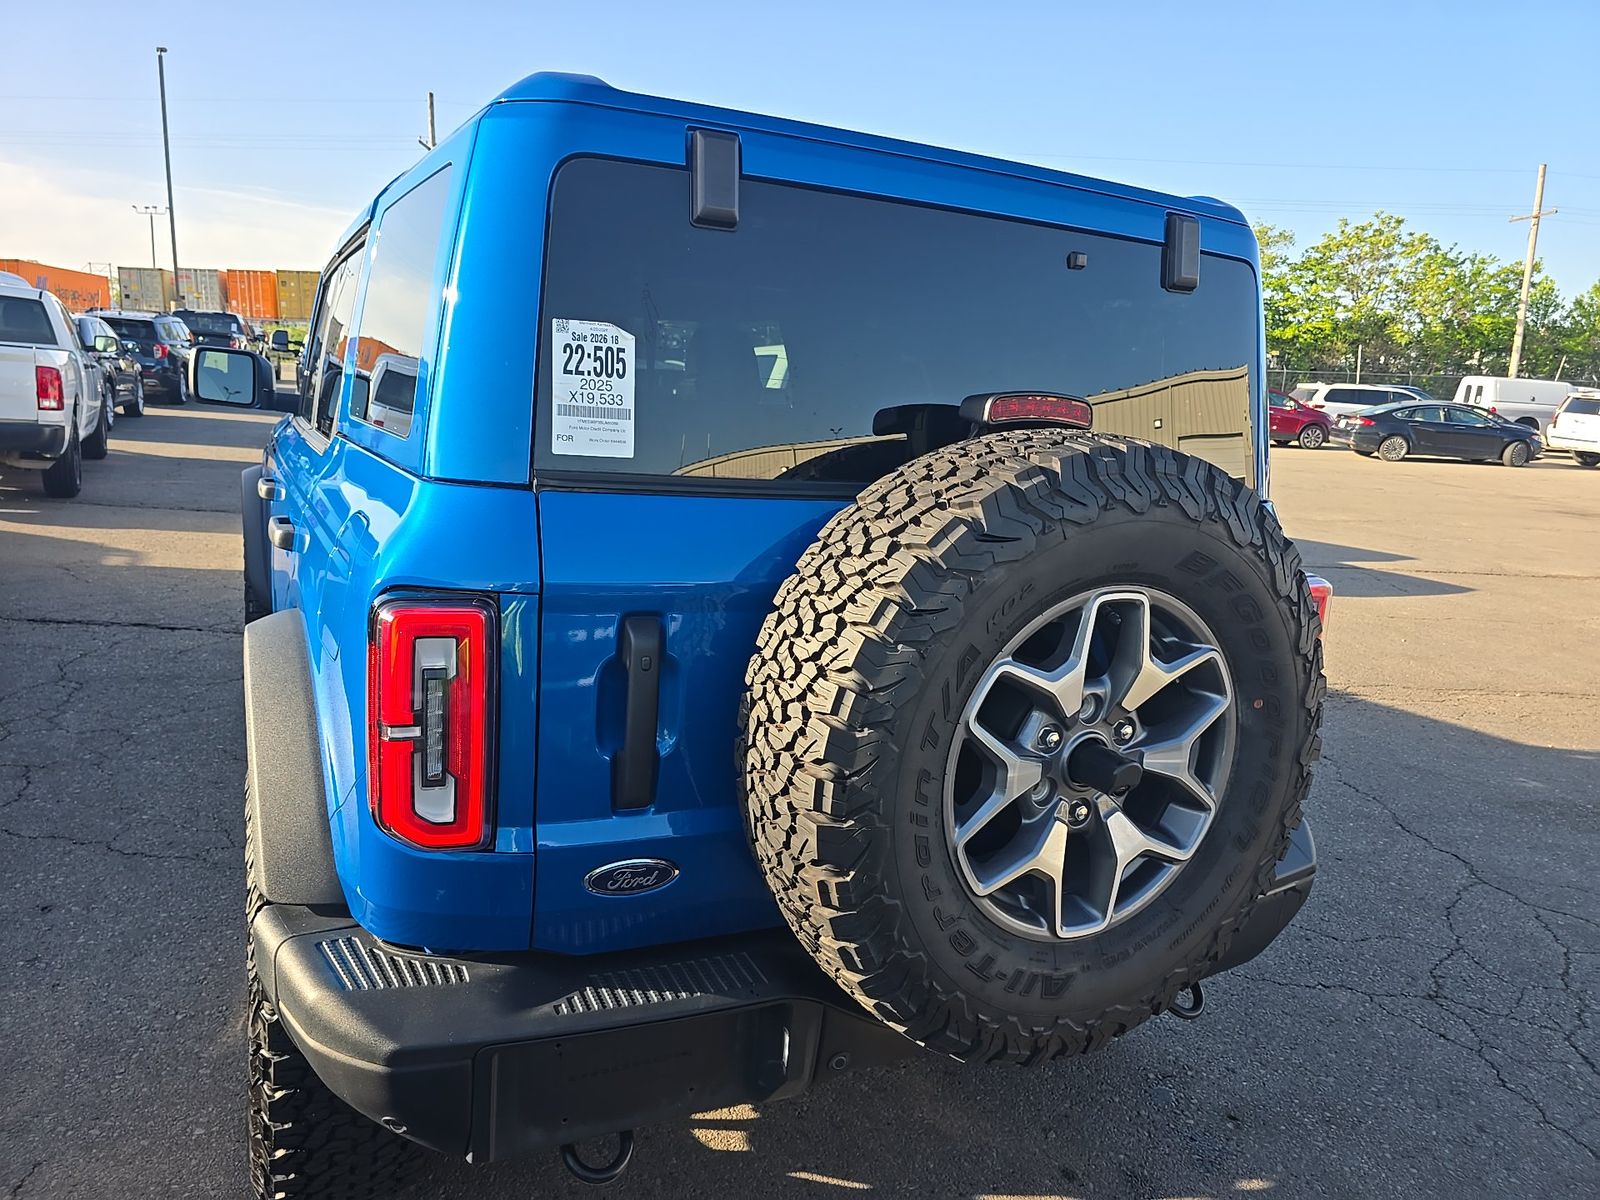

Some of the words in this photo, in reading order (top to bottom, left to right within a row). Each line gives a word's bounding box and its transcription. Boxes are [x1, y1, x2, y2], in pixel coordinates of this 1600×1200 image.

[571, 331, 588, 342] Sale
[589, 333, 608, 344] 2026
[562, 342, 627, 380] 22:505
[579, 378, 613, 391] 2025
[568, 390, 624, 406] X19,533
[556, 433, 574, 442] FOR
[607, 867, 660, 890] Ford
